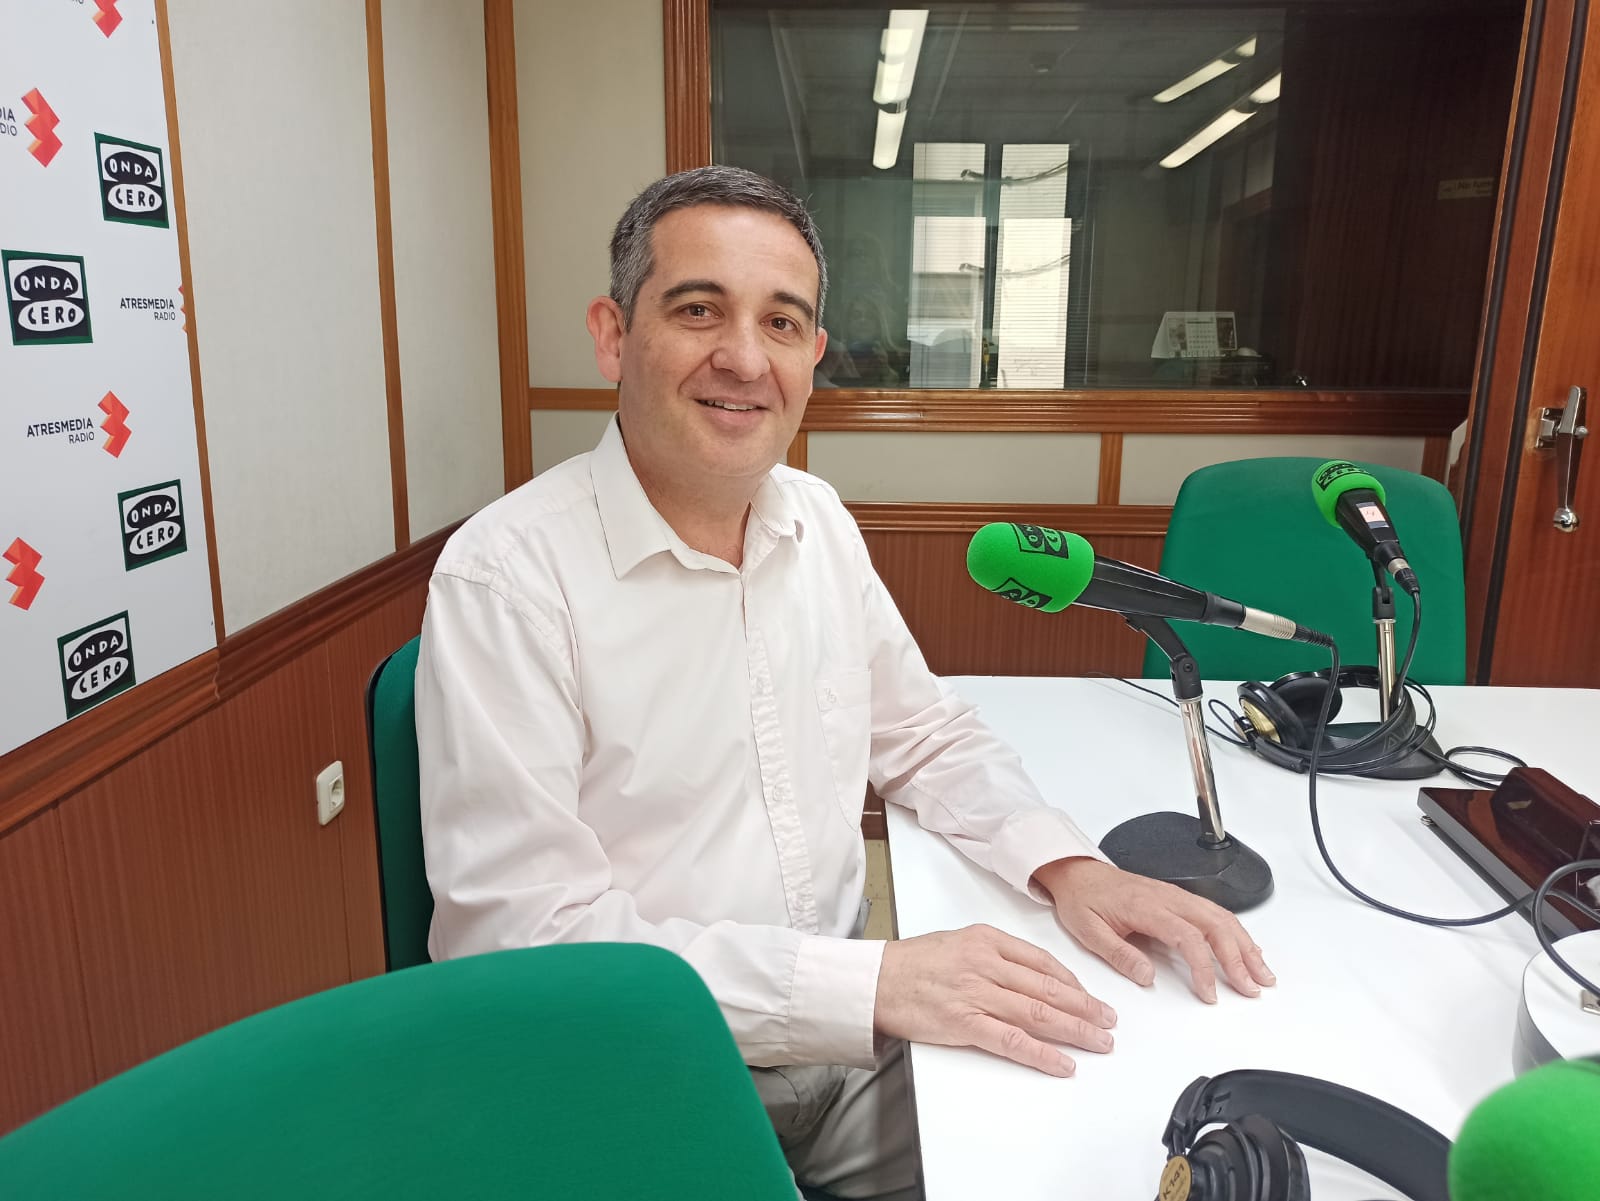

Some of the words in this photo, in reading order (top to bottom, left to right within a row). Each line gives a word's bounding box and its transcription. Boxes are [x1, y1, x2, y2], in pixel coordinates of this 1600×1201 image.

[109, 158, 153, 178] ONDA
[115, 187, 155, 207] CERO
[20, 274, 73, 291] ONDA
[120, 297, 175, 309] ATRESMEDIA
[28, 306, 76, 325] CERO
[154, 311, 176, 320] RADIO
[27, 417, 94, 438] ATRESMEDIA
[69, 431, 95, 444] RADIO
[131, 500, 172, 523] ONDA
[136, 526, 174, 549] CERO
[73, 635, 119, 666] ONDA
[79, 661, 121, 693] CERO
[1163, 1163, 1184, 1200] K141
